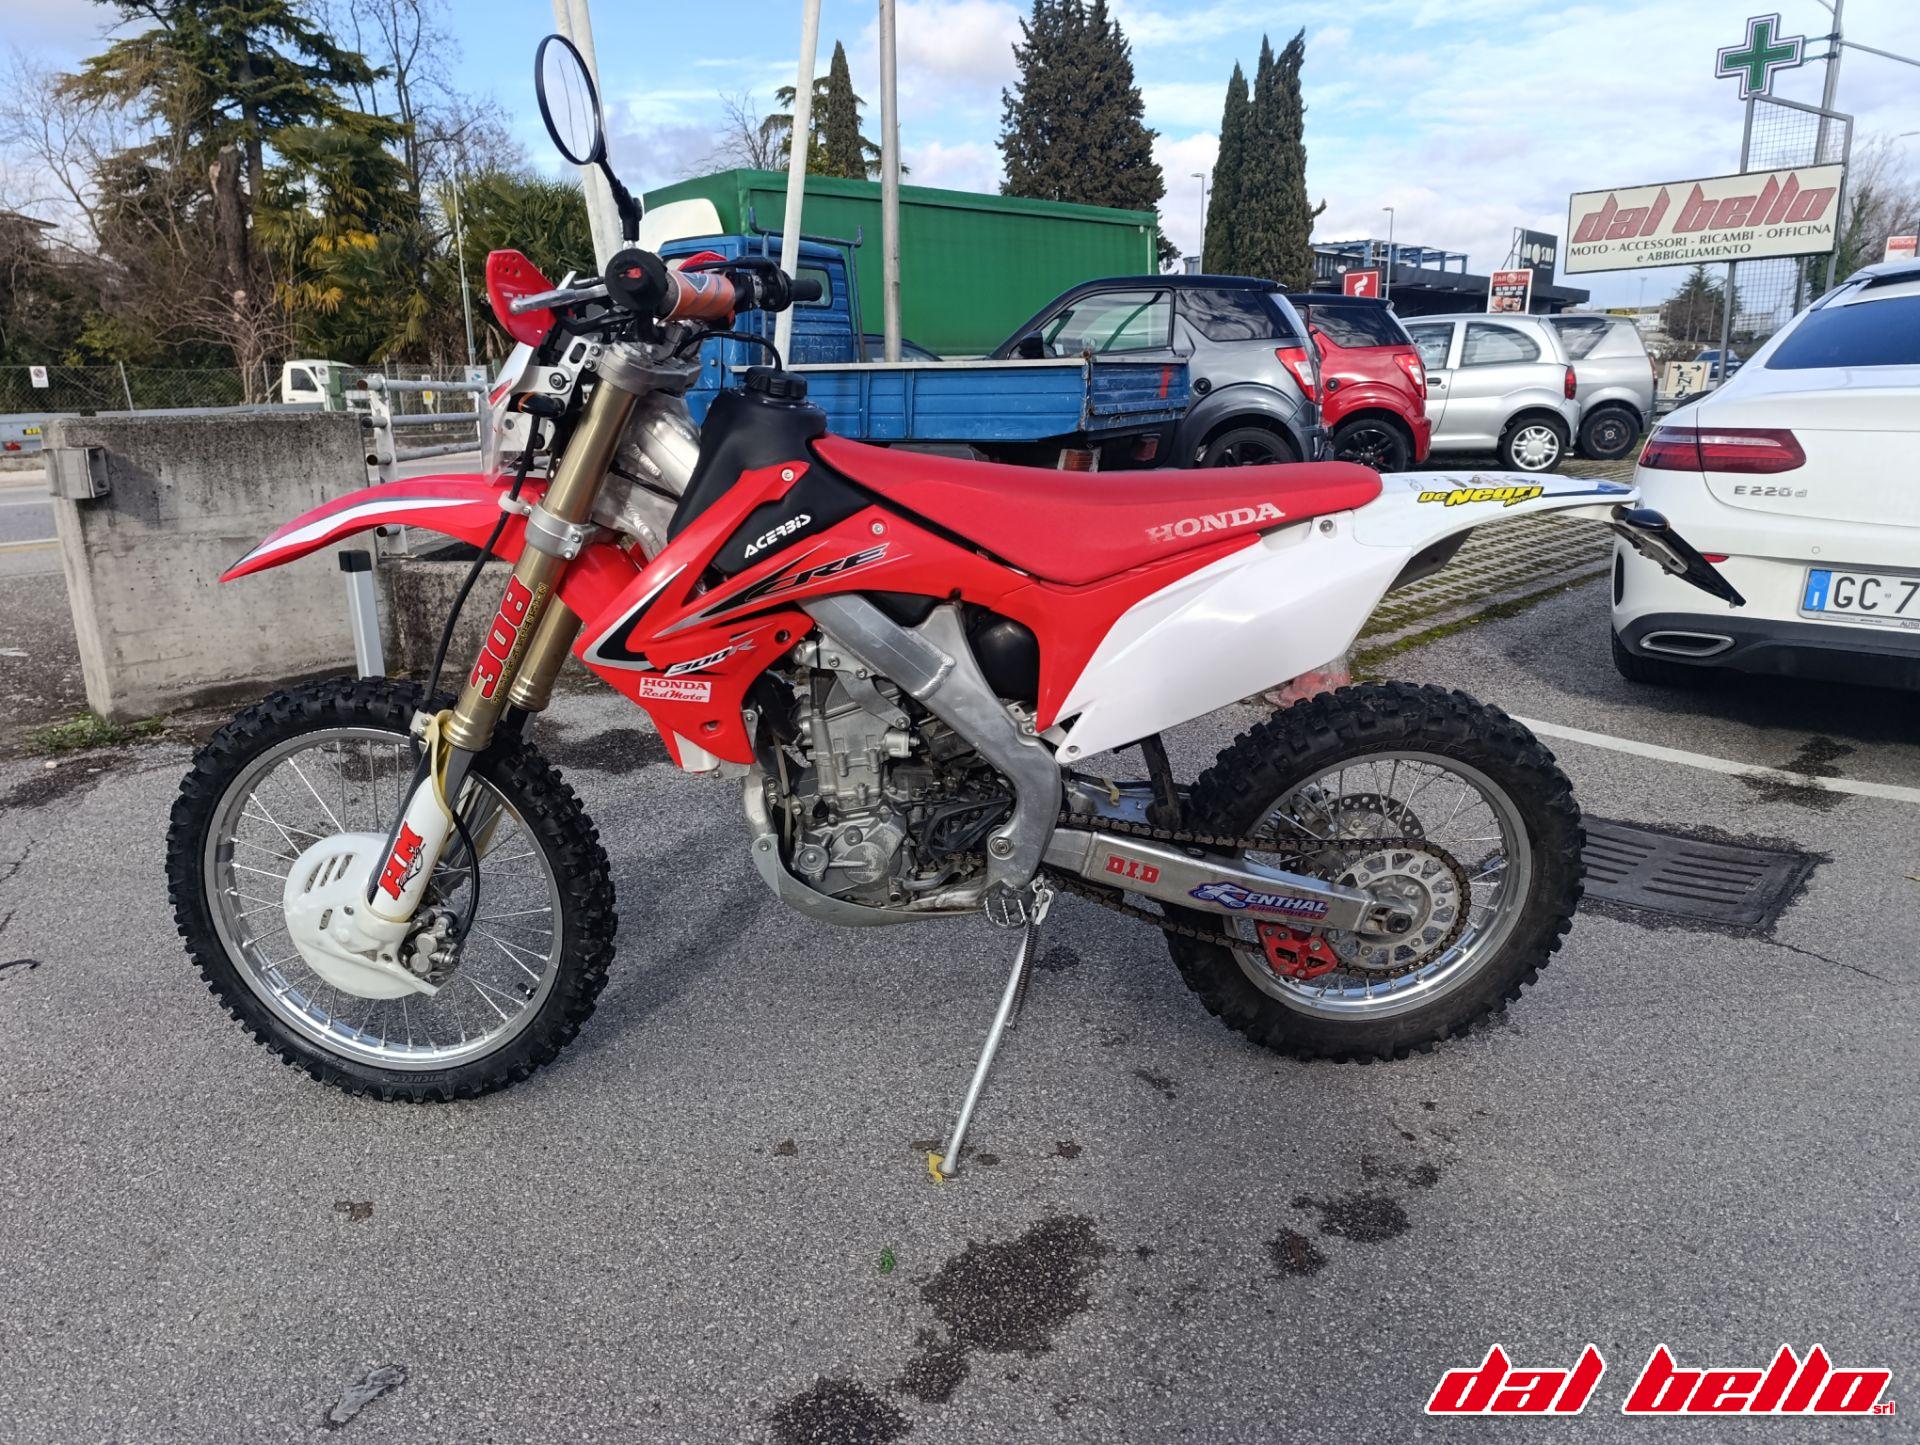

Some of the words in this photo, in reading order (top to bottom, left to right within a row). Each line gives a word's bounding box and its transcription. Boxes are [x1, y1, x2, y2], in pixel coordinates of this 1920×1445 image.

[1572, 186, 1671, 244] dal
[1672, 172, 1837, 234] bello
[1570, 244, 1608, 257] MOTO
[1619, 237, 1687, 253] ACCESSORI
[1699, 231, 1754, 245] RICAMBI
[1766, 223, 1832, 240] OFFICINA
[1636, 254, 1644, 262] e
[1647, 244, 1752, 262] ABBIGLIAMENTO
[1734, 485, 1747, 495] E
[1750, 486, 1793, 497] 220
[1145, 502, 1286, 544] HONDA
[1833, 576, 1882, 611] GC
[1894, 580, 1920, 614] 7
[470, 574, 534, 699] 308
[643, 678, 708, 691] HONDA
